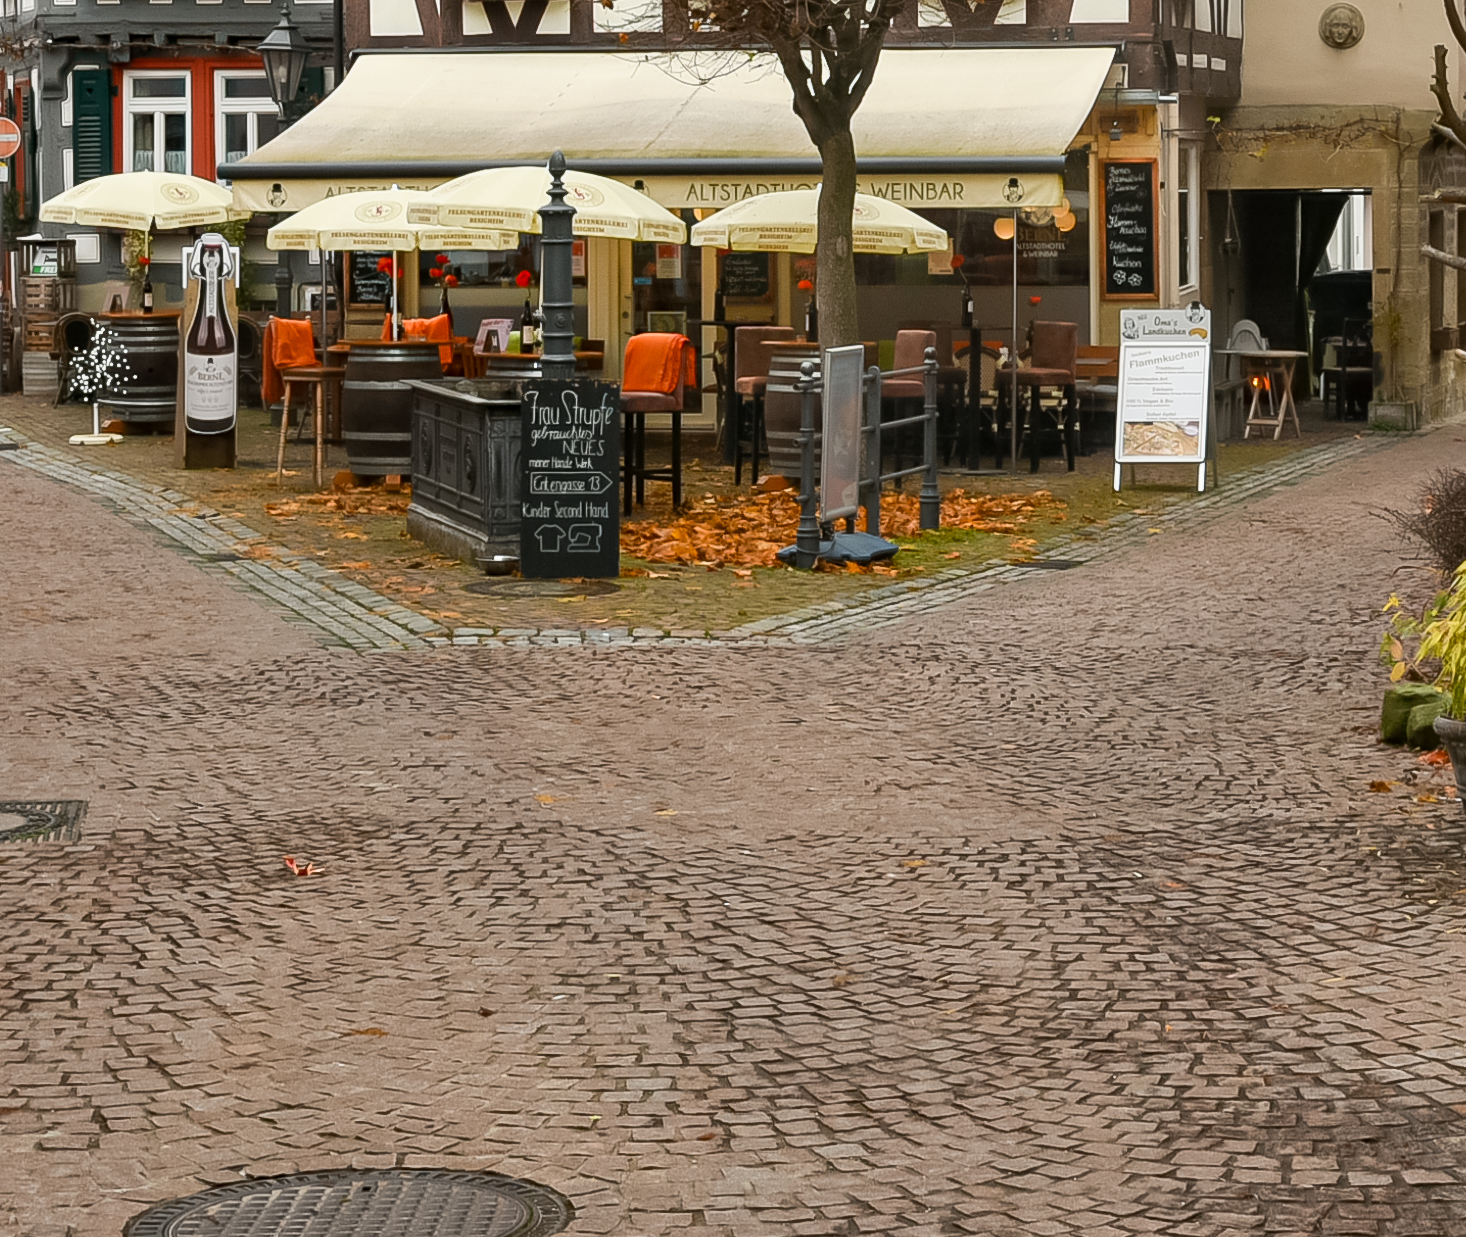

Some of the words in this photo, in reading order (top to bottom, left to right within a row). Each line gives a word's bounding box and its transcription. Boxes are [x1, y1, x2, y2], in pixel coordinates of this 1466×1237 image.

[870, 182, 964, 201] WEINBAR
[1129, 350, 1200, 369] Flammkuchen
[524, 390, 560, 425] Frau
[561, 389, 614, 436] Strupfe
[562, 439, 605, 456] NEUES
[587, 475, 600, 491] 13
[522, 501, 551, 518] Kinder
[554, 501, 582, 518] Second
[585, 501, 609, 518] Hand
